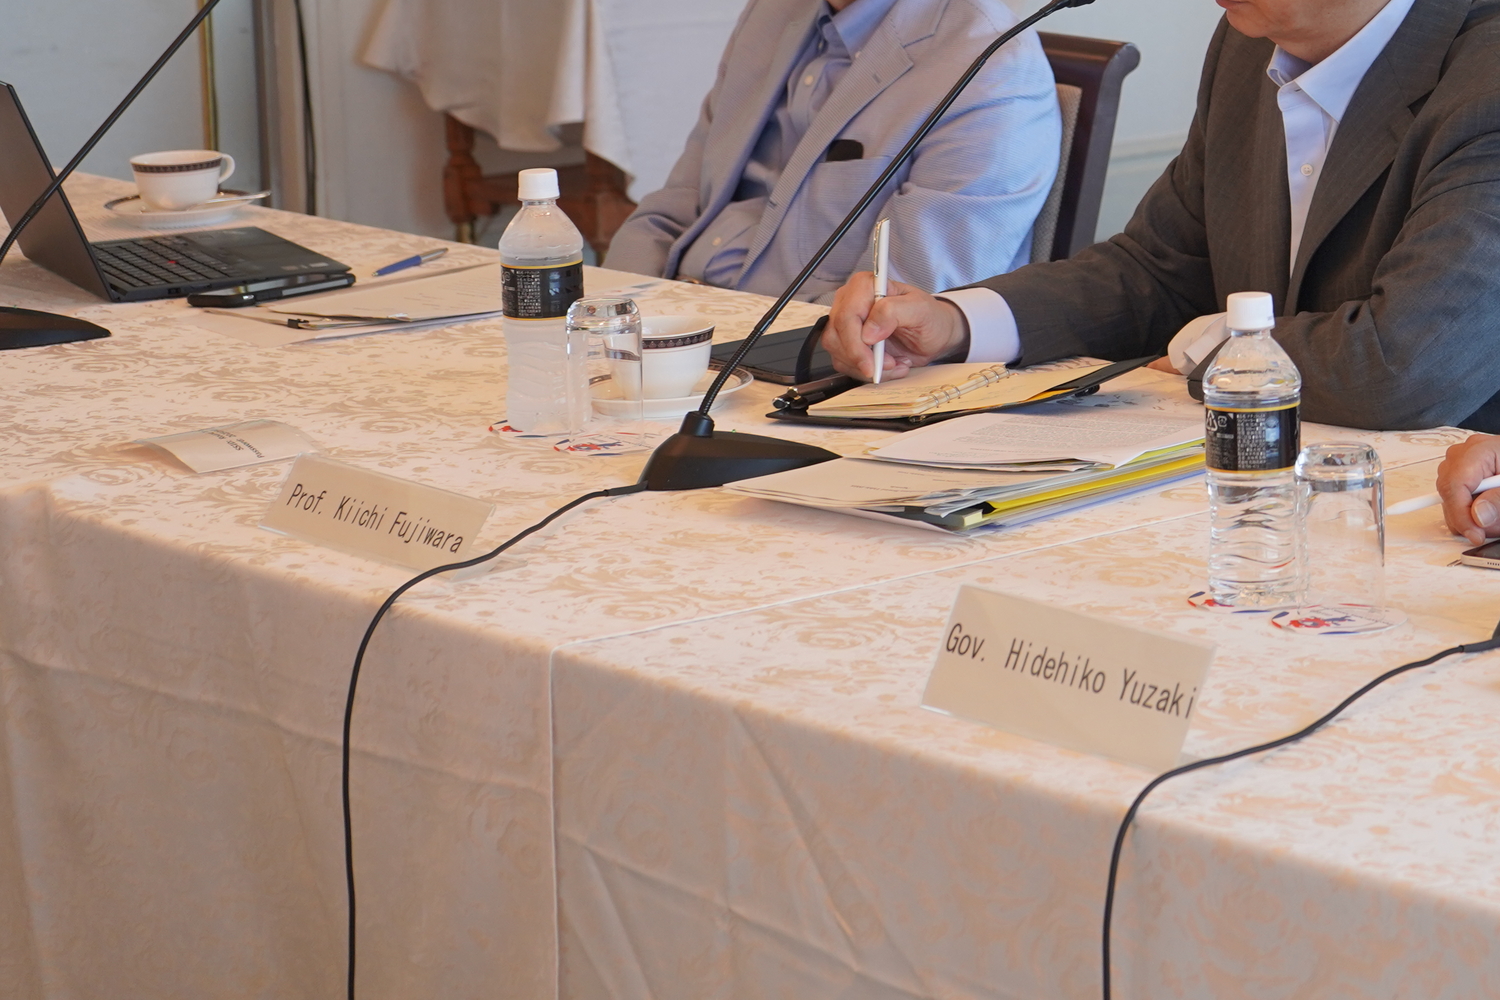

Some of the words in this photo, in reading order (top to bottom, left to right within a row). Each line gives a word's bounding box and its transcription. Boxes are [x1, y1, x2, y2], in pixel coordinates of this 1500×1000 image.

[286, 483, 327, 515] Prof.
[333, 495, 388, 531] Kiichi
[388, 511, 464, 554] Fujiwara
[945, 622, 986, 662] Gov.
[1003, 637, 1106, 694] Hidehiko
[1119, 667, 1197, 719] Yuzaki
